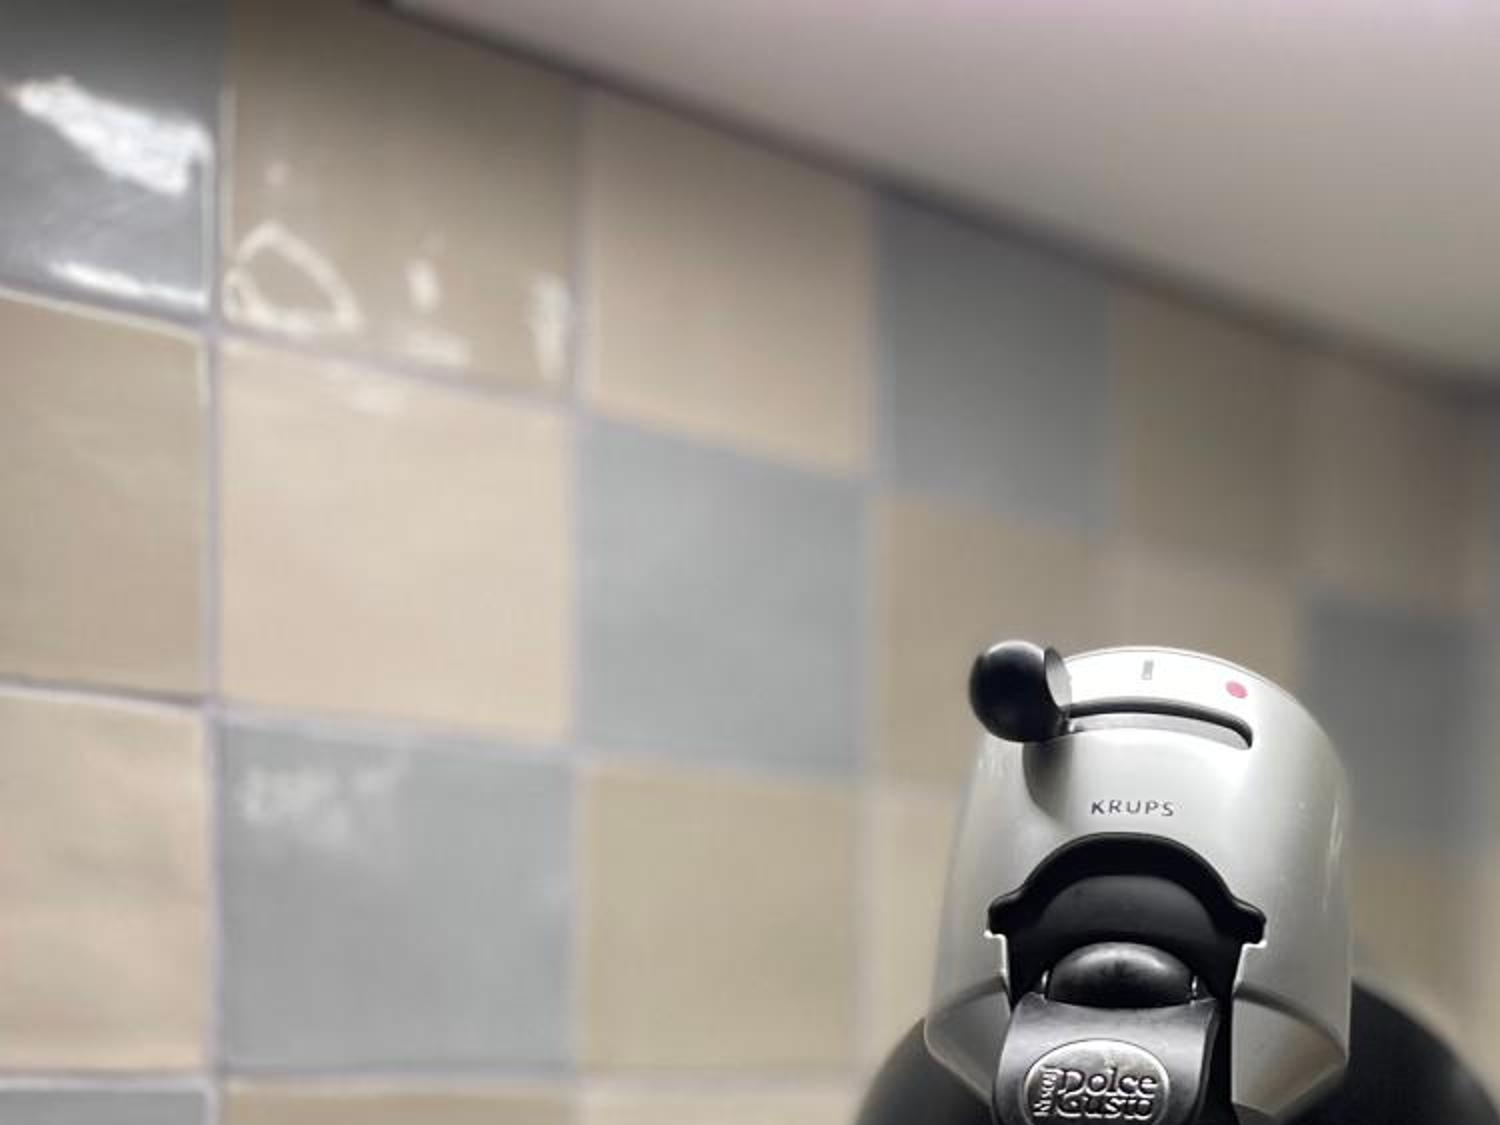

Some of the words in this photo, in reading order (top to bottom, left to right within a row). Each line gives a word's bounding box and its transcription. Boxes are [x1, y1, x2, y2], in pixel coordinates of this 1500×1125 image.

[1090, 800, 1174, 816] KRUPS
[1056, 1066, 1158, 1098] Dolce
[1056, 1094, 1153, 1121] Gusto
